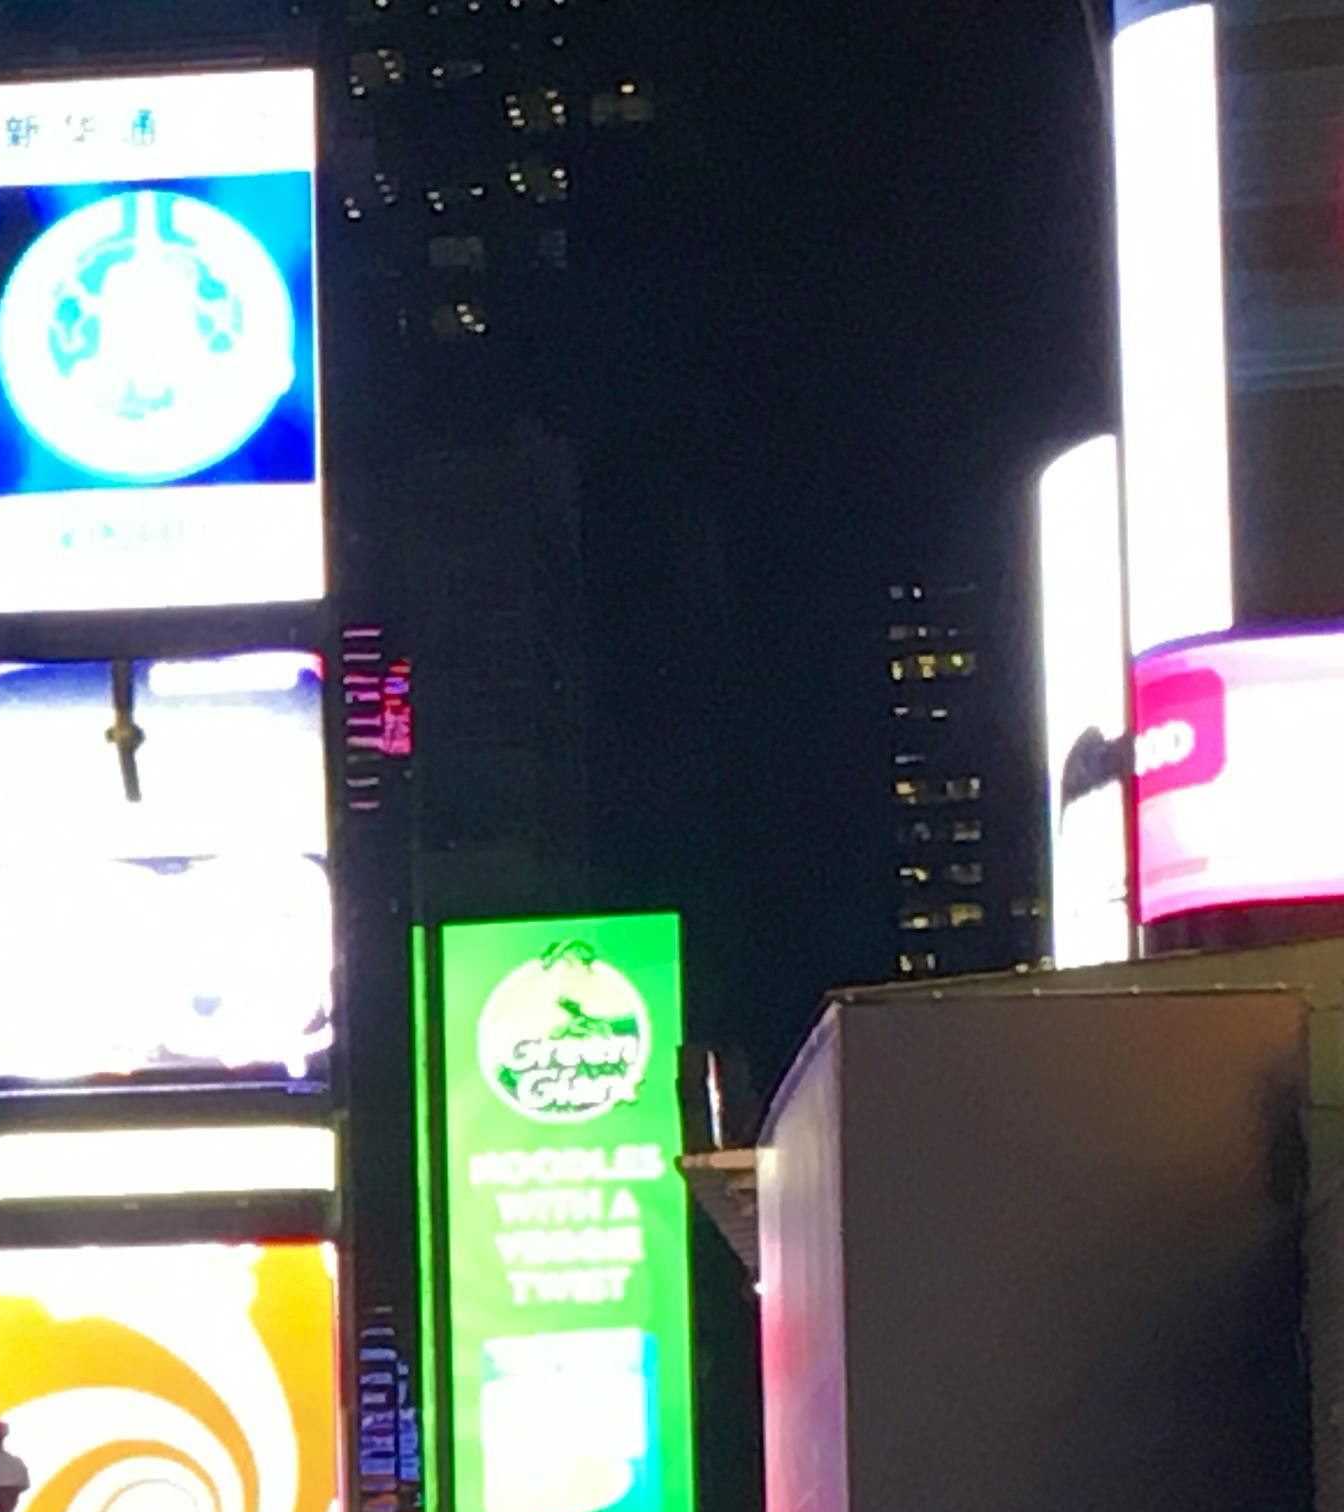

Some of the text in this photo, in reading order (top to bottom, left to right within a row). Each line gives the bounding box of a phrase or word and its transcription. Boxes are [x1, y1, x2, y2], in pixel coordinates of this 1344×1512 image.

[468, 1145, 666, 1187] NOODLES
[495, 1187, 640, 1225] WITH A
[494, 1225, 644, 1265] VEGGIE
[507, 1266, 632, 1305] TWIST
